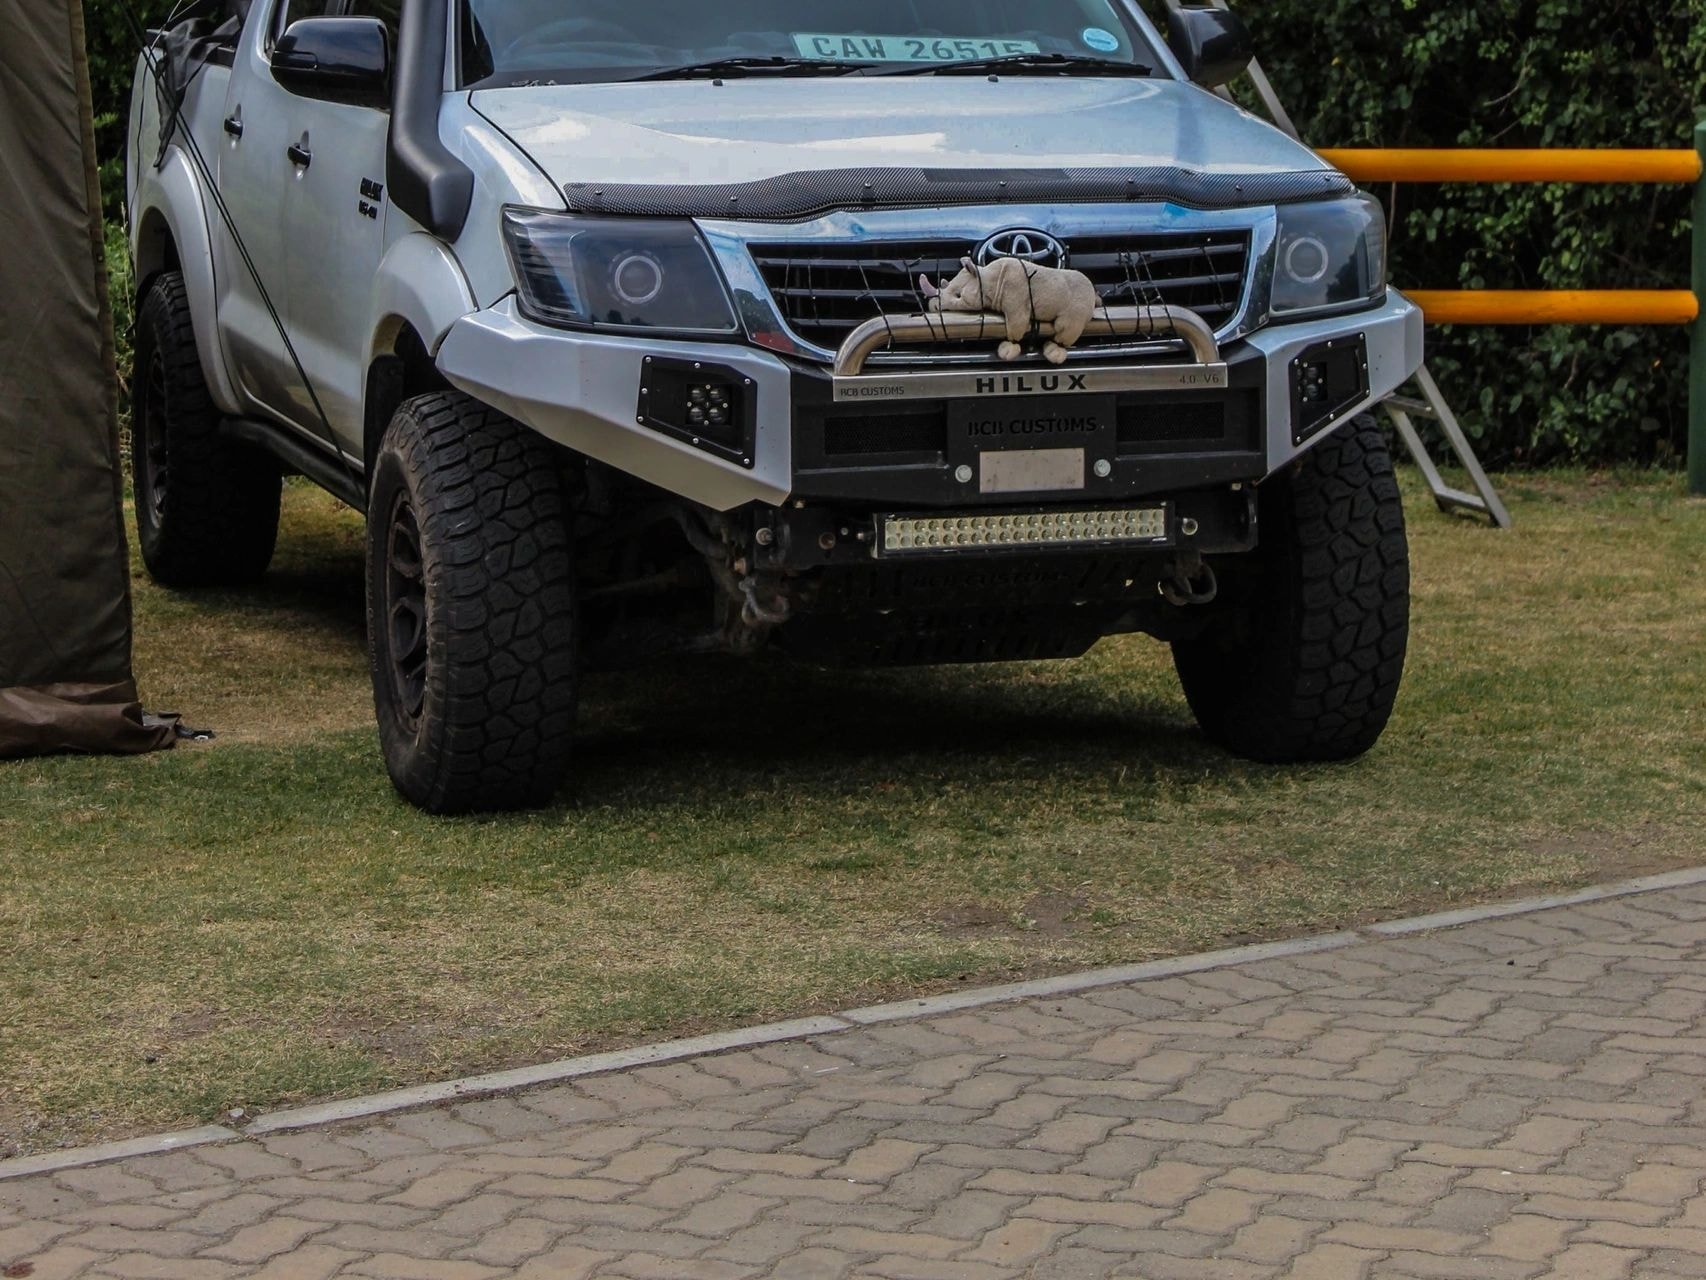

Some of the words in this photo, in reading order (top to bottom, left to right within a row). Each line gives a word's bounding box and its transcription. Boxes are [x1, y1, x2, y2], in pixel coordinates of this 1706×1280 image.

[811, 37, 887, 59] CAW
[975, 373, 1087, 394] HILUX
[1203, 373, 1220, 384] V6
[860, 385, 905, 397] CUSTOMS
[1008, 416, 1098, 434] CUSTOMS
